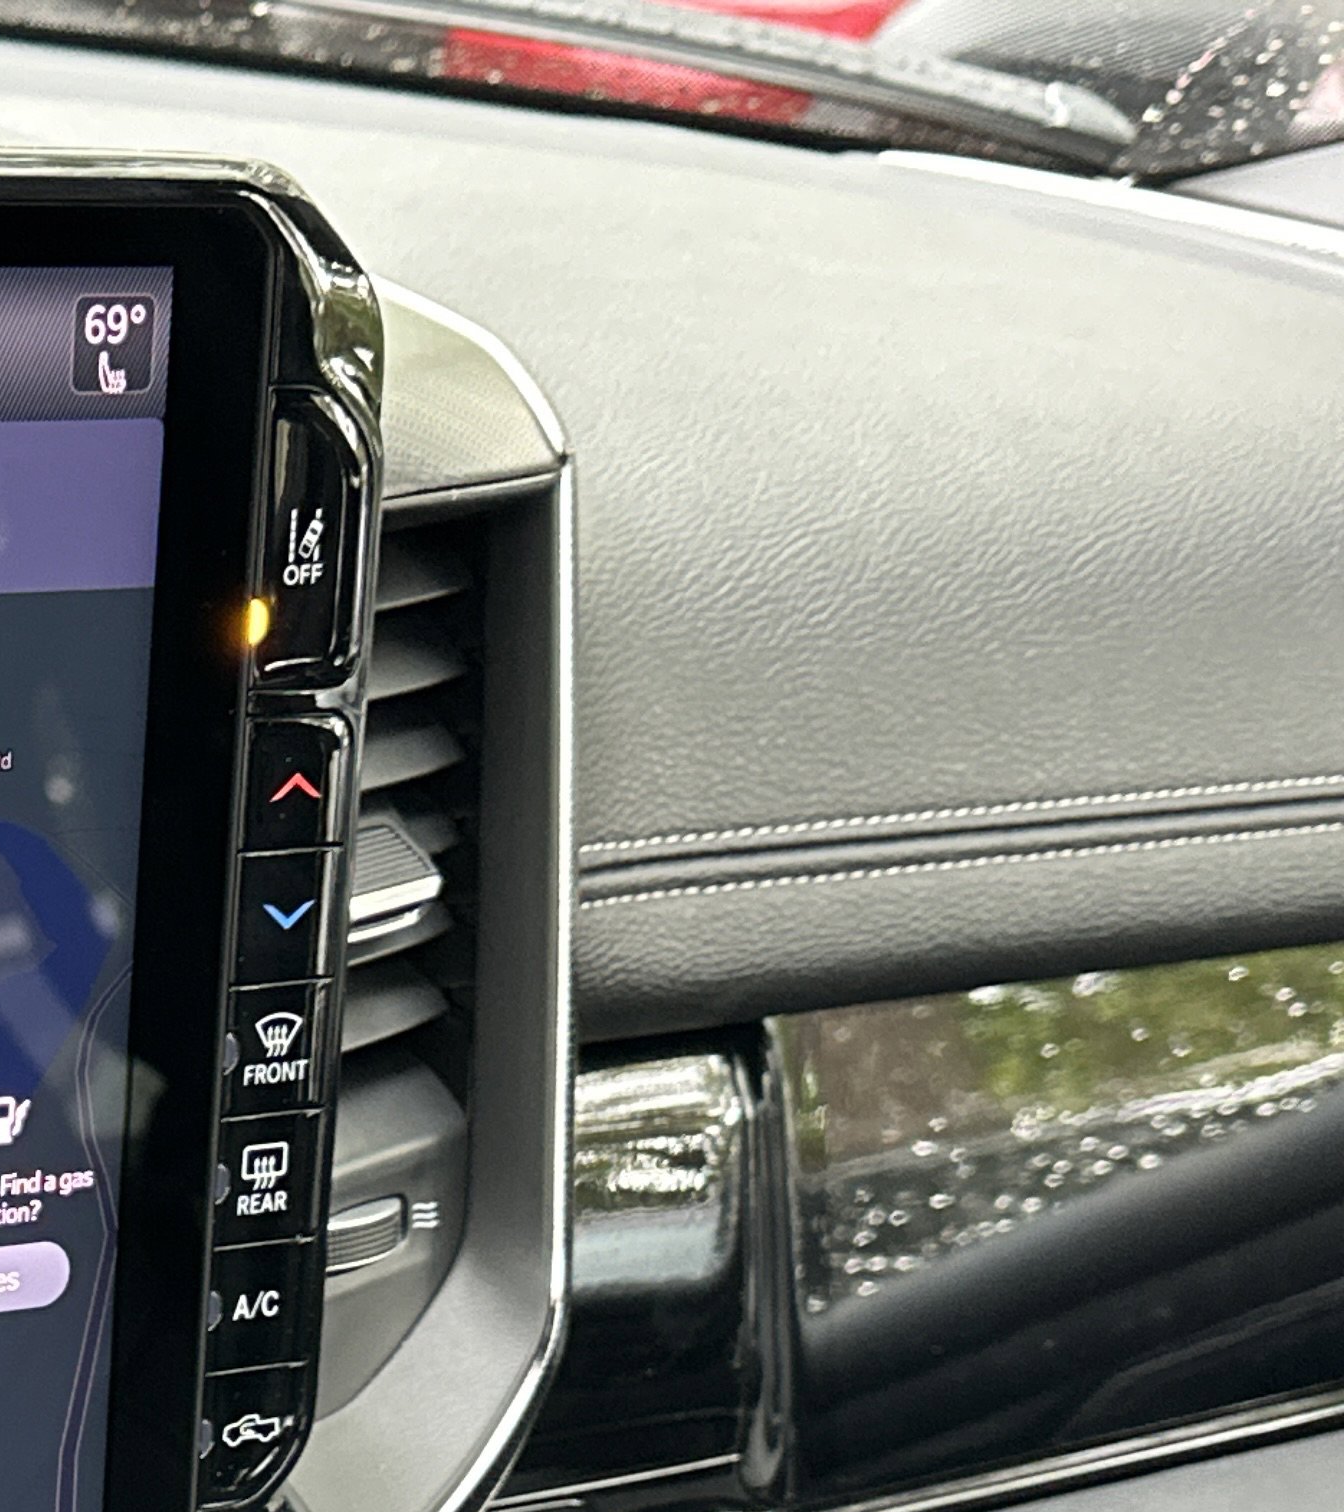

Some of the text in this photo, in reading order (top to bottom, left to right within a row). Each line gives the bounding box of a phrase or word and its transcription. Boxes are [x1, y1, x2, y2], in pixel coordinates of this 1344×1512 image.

[85, 304, 145, 344] 69°
[283, 563, 323, 586] OFF
[243, 1059, 309, 1085] FRONT
[0, 1170, 42, 1198] Find
[44, 1176, 55, 1191] a
[59, 1169, 94, 1192] gas
[237, 1191, 287, 1215] REAR
[233, 1291, 279, 1320] A/C
